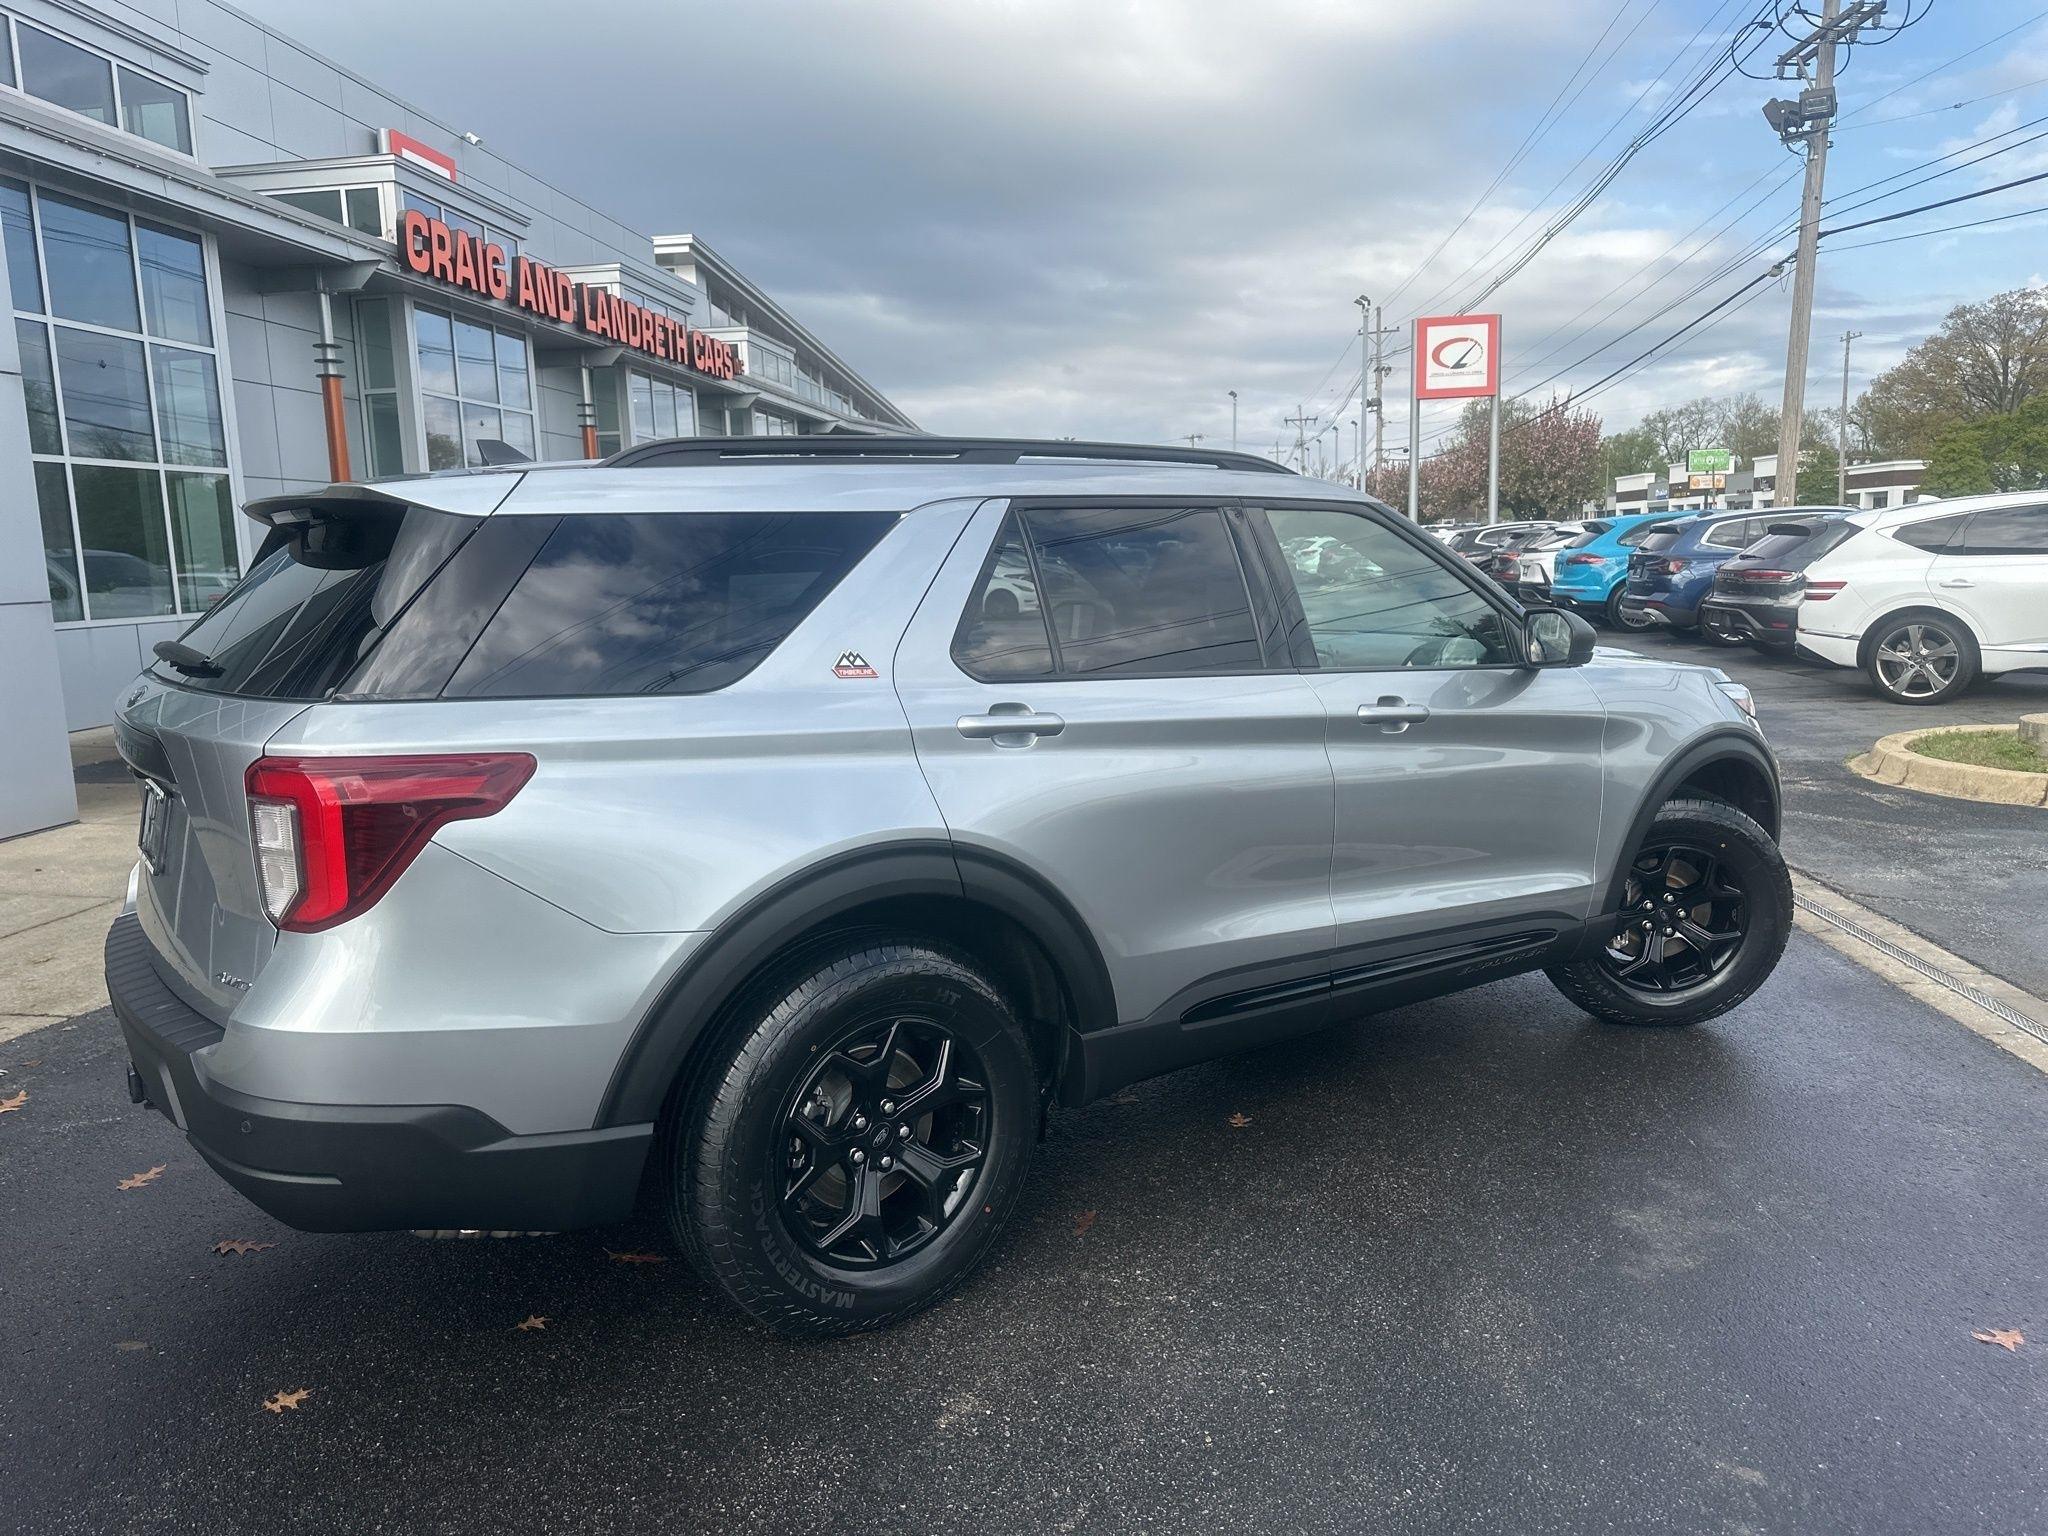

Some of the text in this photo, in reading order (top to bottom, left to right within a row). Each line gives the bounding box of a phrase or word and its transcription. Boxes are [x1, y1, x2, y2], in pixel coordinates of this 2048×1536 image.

[403, 209, 507, 300] CRAIG
[517, 256, 575, 324] AND
[581, 283, 689, 365] LANDRETH
[692, 331, 733, 380] CARS
